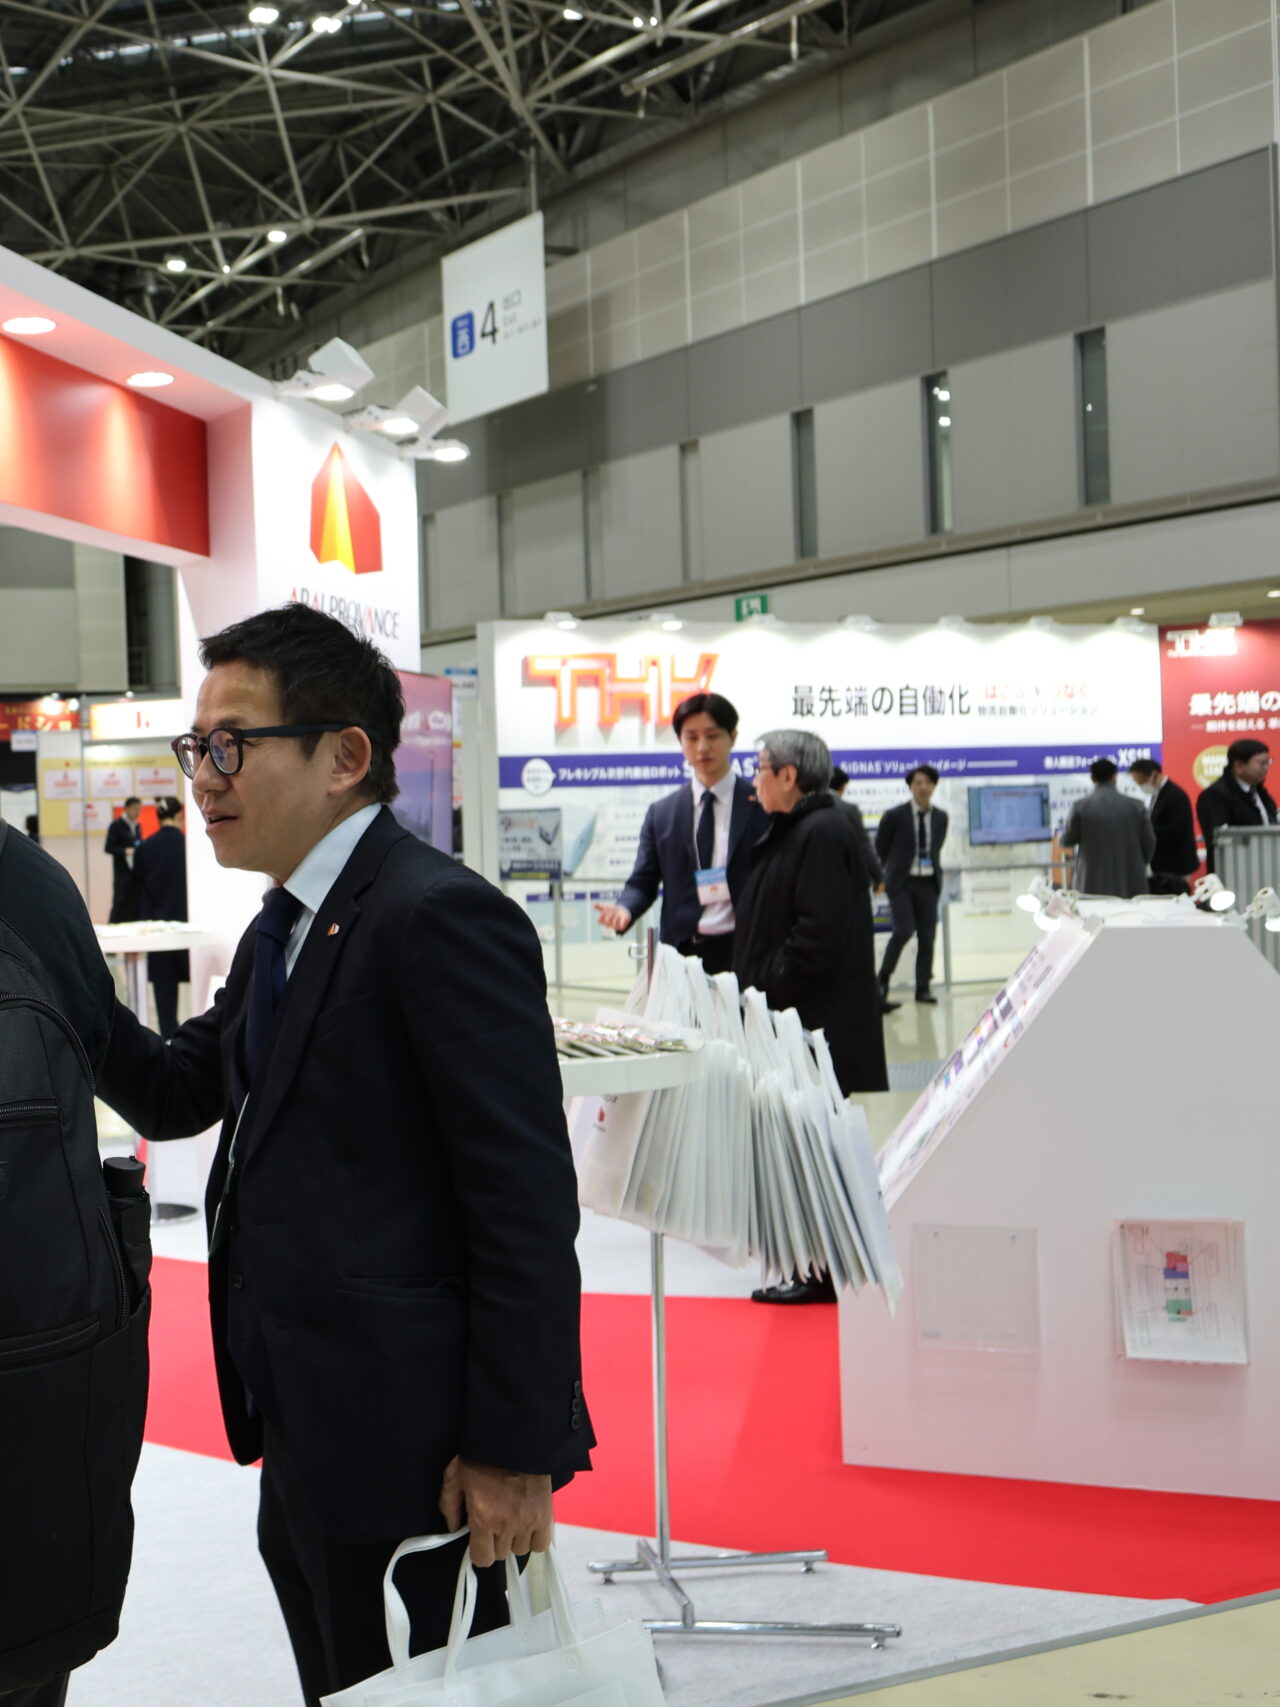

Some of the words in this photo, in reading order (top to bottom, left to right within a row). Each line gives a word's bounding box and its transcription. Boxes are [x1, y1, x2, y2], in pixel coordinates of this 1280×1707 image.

[480, 300, 499, 344] 4
[523, 653, 719, 728] THK
[792, 684, 971, 718] 最先端の自働化
